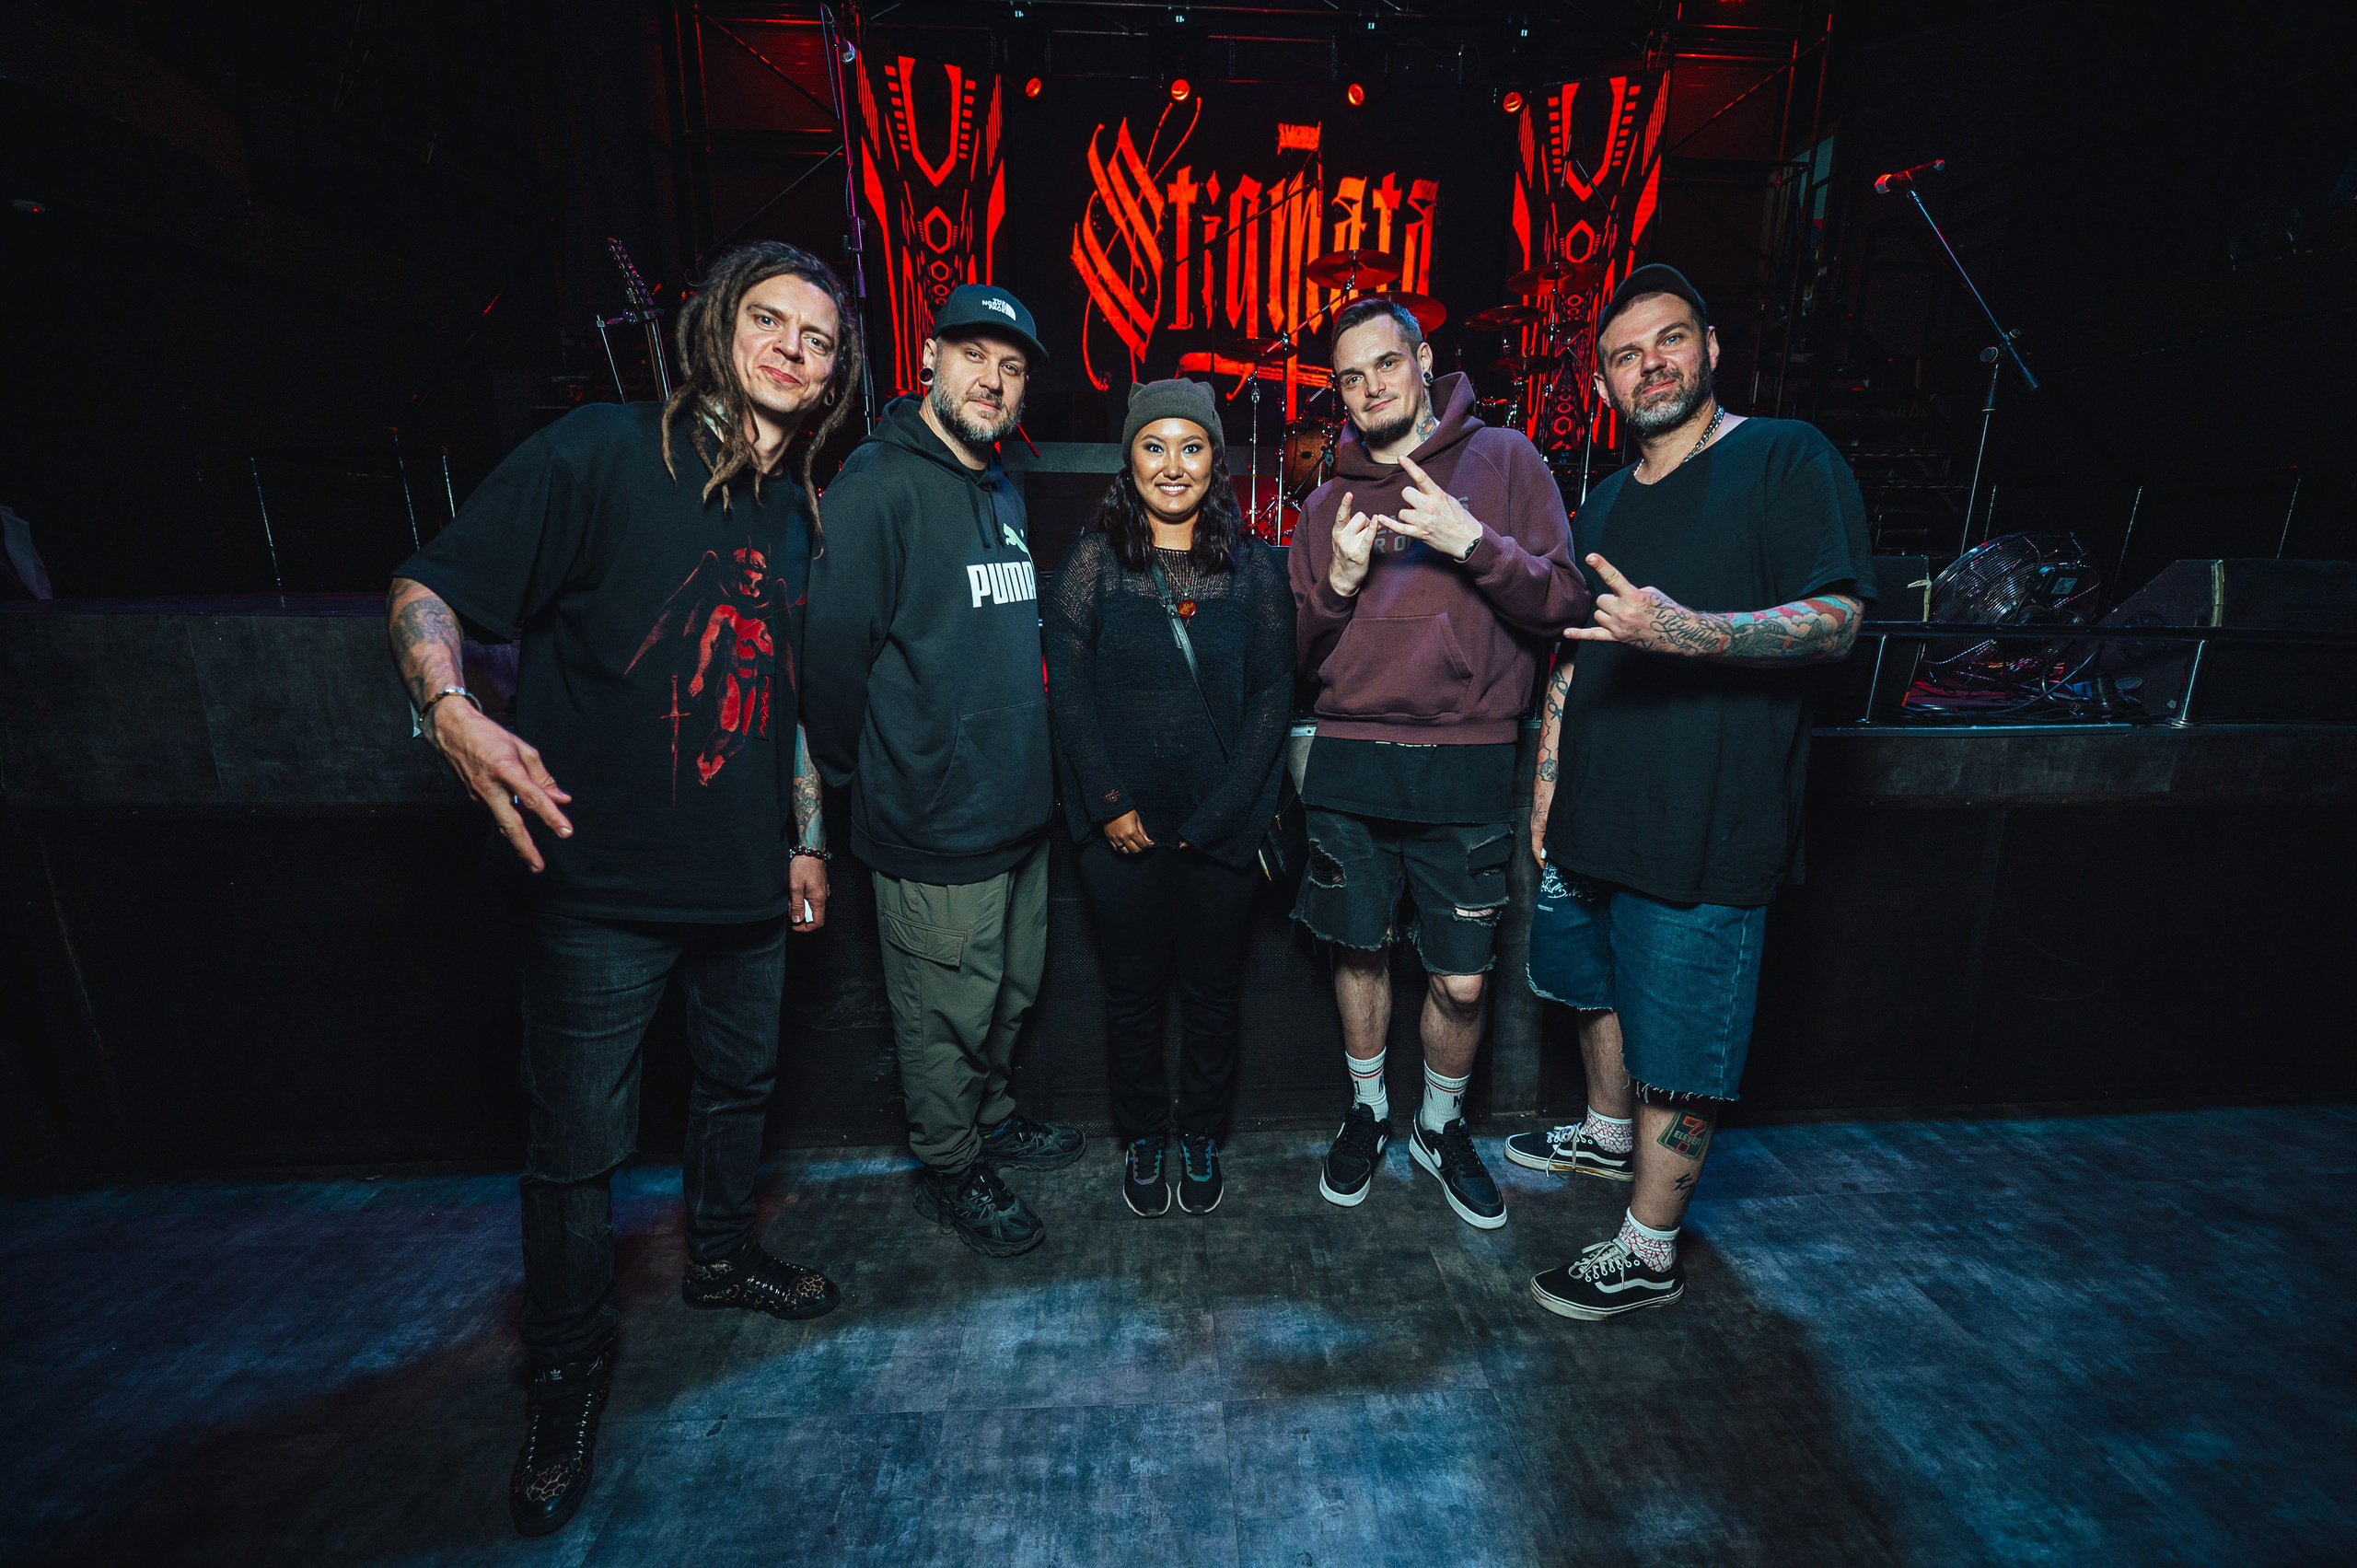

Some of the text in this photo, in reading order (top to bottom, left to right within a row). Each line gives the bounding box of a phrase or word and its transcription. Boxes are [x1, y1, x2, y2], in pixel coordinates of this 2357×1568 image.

[1071, 103, 1441, 389] Stigmata
[981, 299, 1006, 310] NORTH
[988, 304, 1006, 314] FACE
[967, 562, 1037, 608] PUMA
